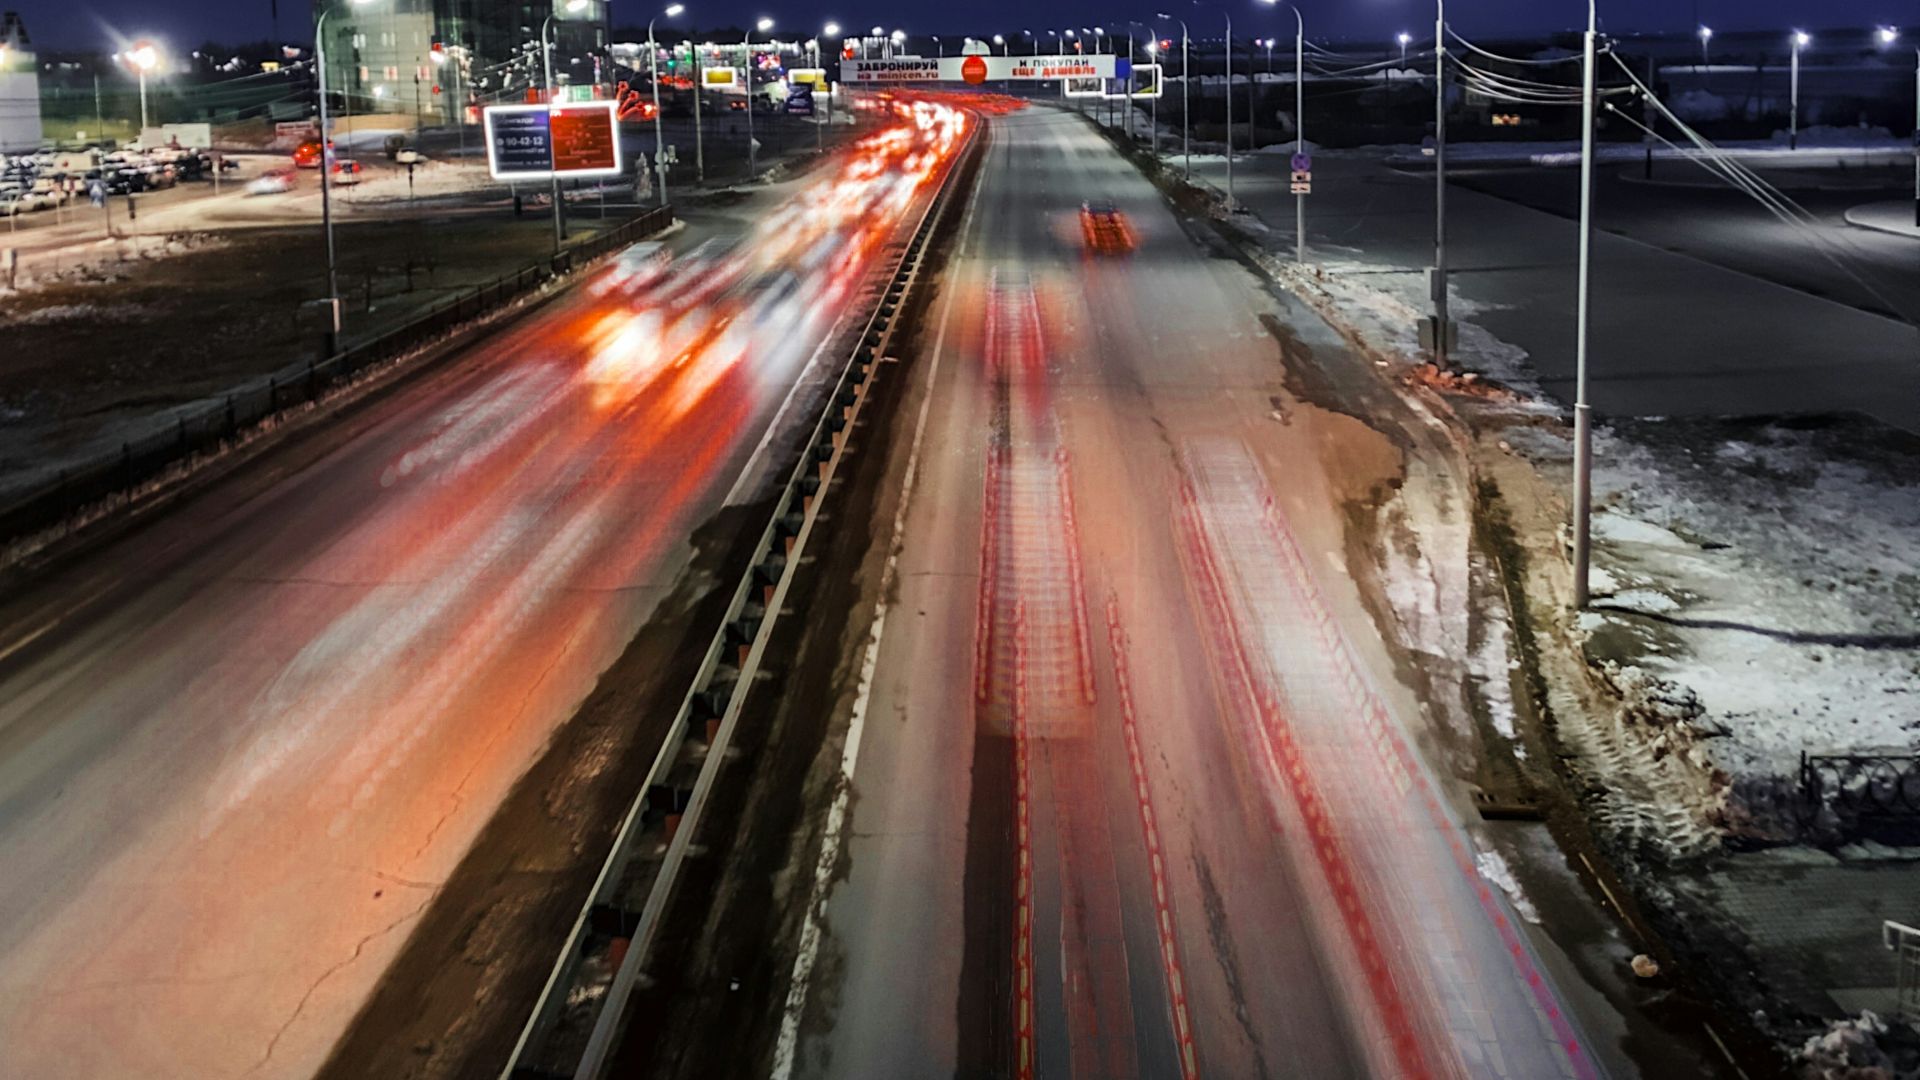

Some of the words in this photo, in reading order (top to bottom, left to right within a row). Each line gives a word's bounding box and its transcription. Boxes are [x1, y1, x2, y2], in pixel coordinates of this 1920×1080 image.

[857, 59, 939, 72] ЗАБРОНИРУЙ
[877, 71, 939, 80] minicen.ru
[1042, 67, 1096, 77] ДЕШЕВЛЕ
